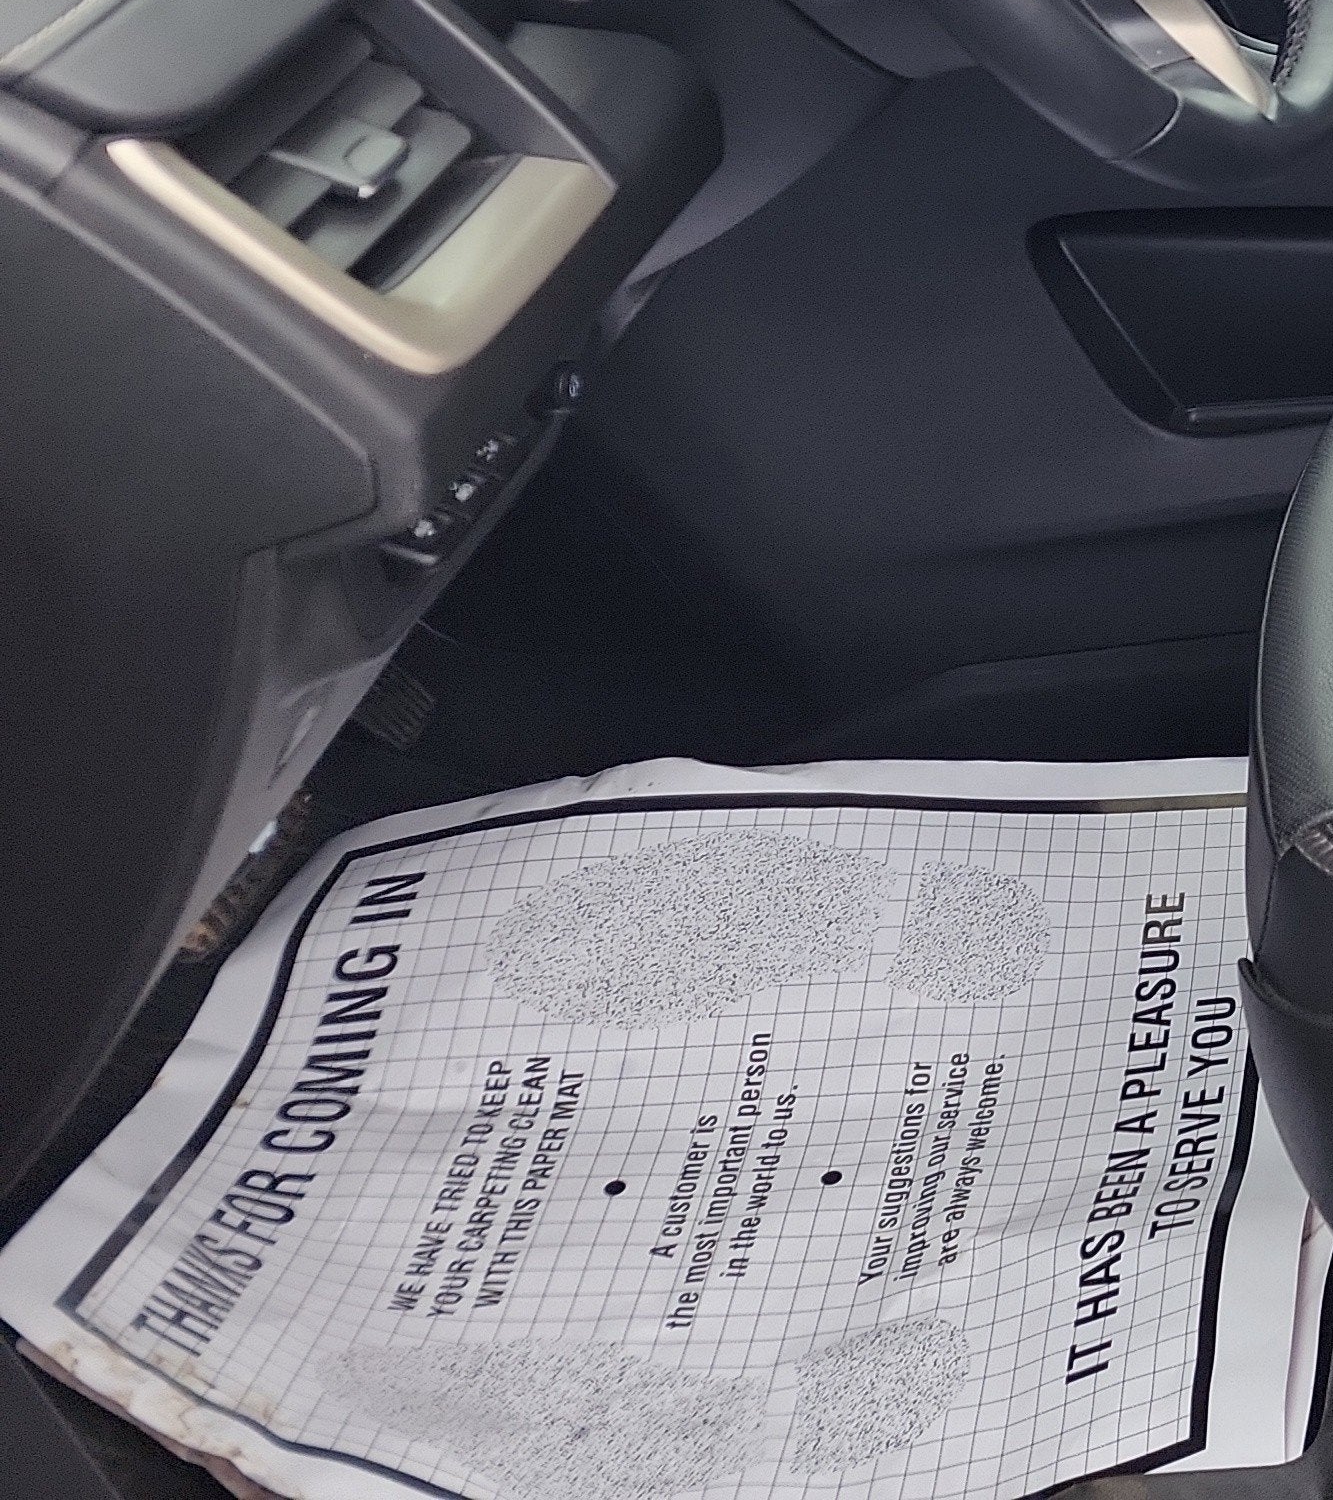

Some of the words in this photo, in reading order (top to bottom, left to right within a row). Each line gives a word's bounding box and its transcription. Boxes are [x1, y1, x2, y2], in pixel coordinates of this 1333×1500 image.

[350, 872, 426, 925] IN
[1120, 892, 1185, 1101] PLEASURE
[261, 943, 400, 1153] COMING
[1187, 997, 1236, 1078] YOU
[474, 1060, 513, 1118] KEEP
[737, 1032, 772, 1117] person
[773, 1084, 798, 1120] us.
[937, 1052, 970, 1130] service
[965, 1054, 1006, 1151] welcome.
[461, 1123, 493, 1147] TO
[690, 1114, 718, 1134] is
[761, 1128, 788, 1149] to
[1113, 1110, 1158, 1133] A
[1163, 1085, 1225, 1191] SERVE
[698, 1125, 752, 1225] important
[858, 1235, 893, 1286] Your
[878, 1102, 925, 1230] suggestions
[904, 1062, 932, 1096] for
[928, 1135, 951, 1168] our
[209, 1169, 315, 1245] FOR
[427, 1258, 476, 1318] YOUR
[456, 1134, 527, 1251] CARPETING
[509, 1056, 551, 1131] CLEAN
[432, 1153, 480, 1214] TRIED
[474, 1251, 518, 1308] WITH
[499, 1198, 541, 1243] THIS
[522, 1127, 569, 1191] PAPER
[550, 1069, 584, 1120] MAT
[662, 1141, 710, 1237] customer
[746, 1154, 781, 1211] world
[942, 1156, 983, 1224] always
[1087, 1148, 1151, 1223] BEEN
[405, 1220, 453, 1276] HAVE
[729, 1215, 761, 1250] the
[893, 1170, 946, 1282] improving
[938, 1228, 960, 1267] are
[1148, 1198, 1200, 1239] TO
[650, 1243, 677, 1258] A
[684, 1230, 719, 1284] most
[719, 1256, 750, 1277] in
[1074, 1229, 1125, 1328] HAS
[130, 1234, 262, 1357] THANKS
[387, 1283, 425, 1310] WE
[666, 1291, 699, 1328] the
[1065, 1339, 1112, 1385] IT
